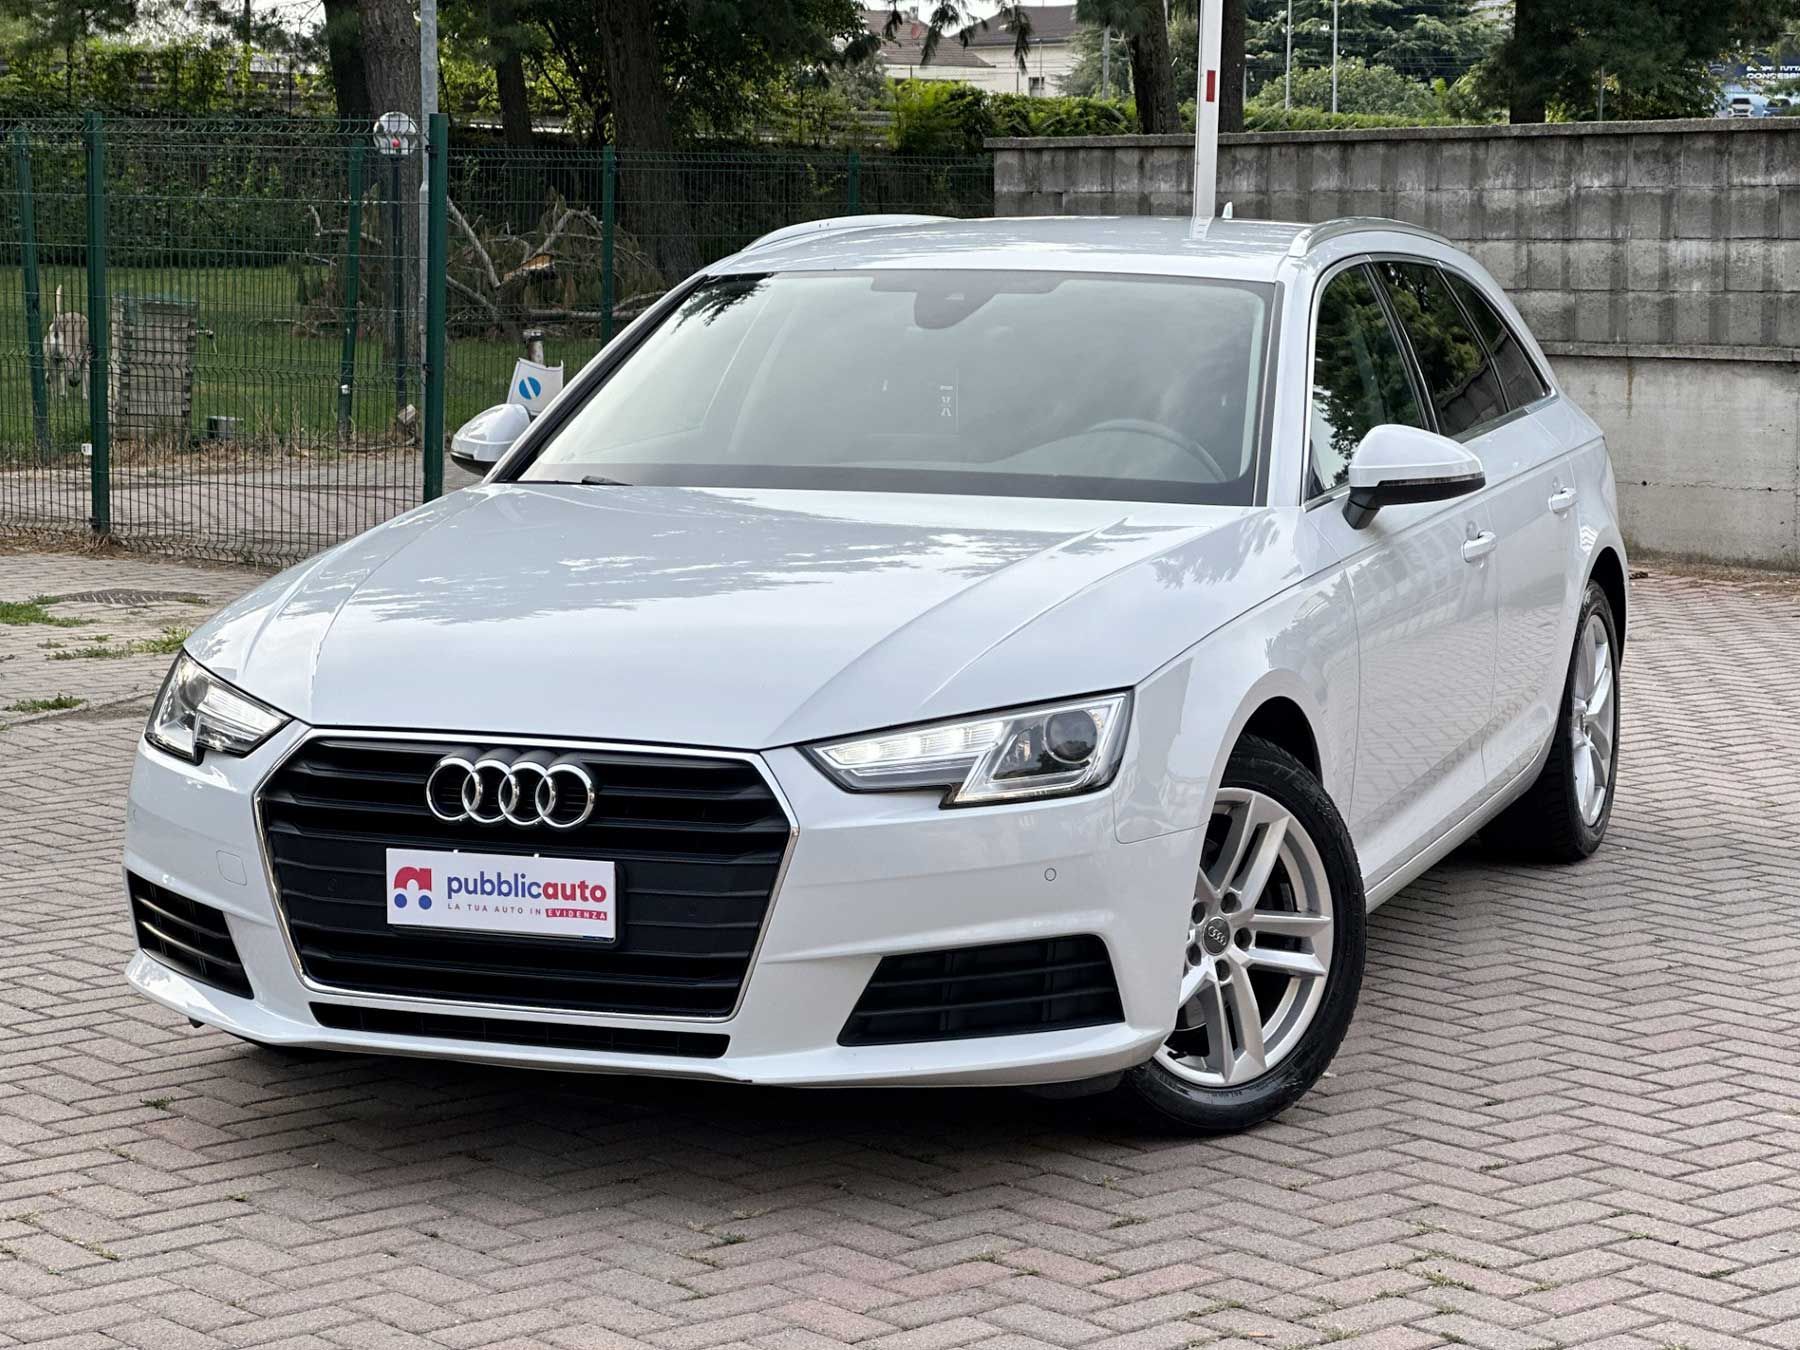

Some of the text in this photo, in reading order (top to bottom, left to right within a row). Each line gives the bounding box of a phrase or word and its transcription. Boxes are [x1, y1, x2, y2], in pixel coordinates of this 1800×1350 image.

[447, 871, 607, 903] pubblicauto
[447, 903, 607, 920] LA TUA AUTO IN EVIDENZA
